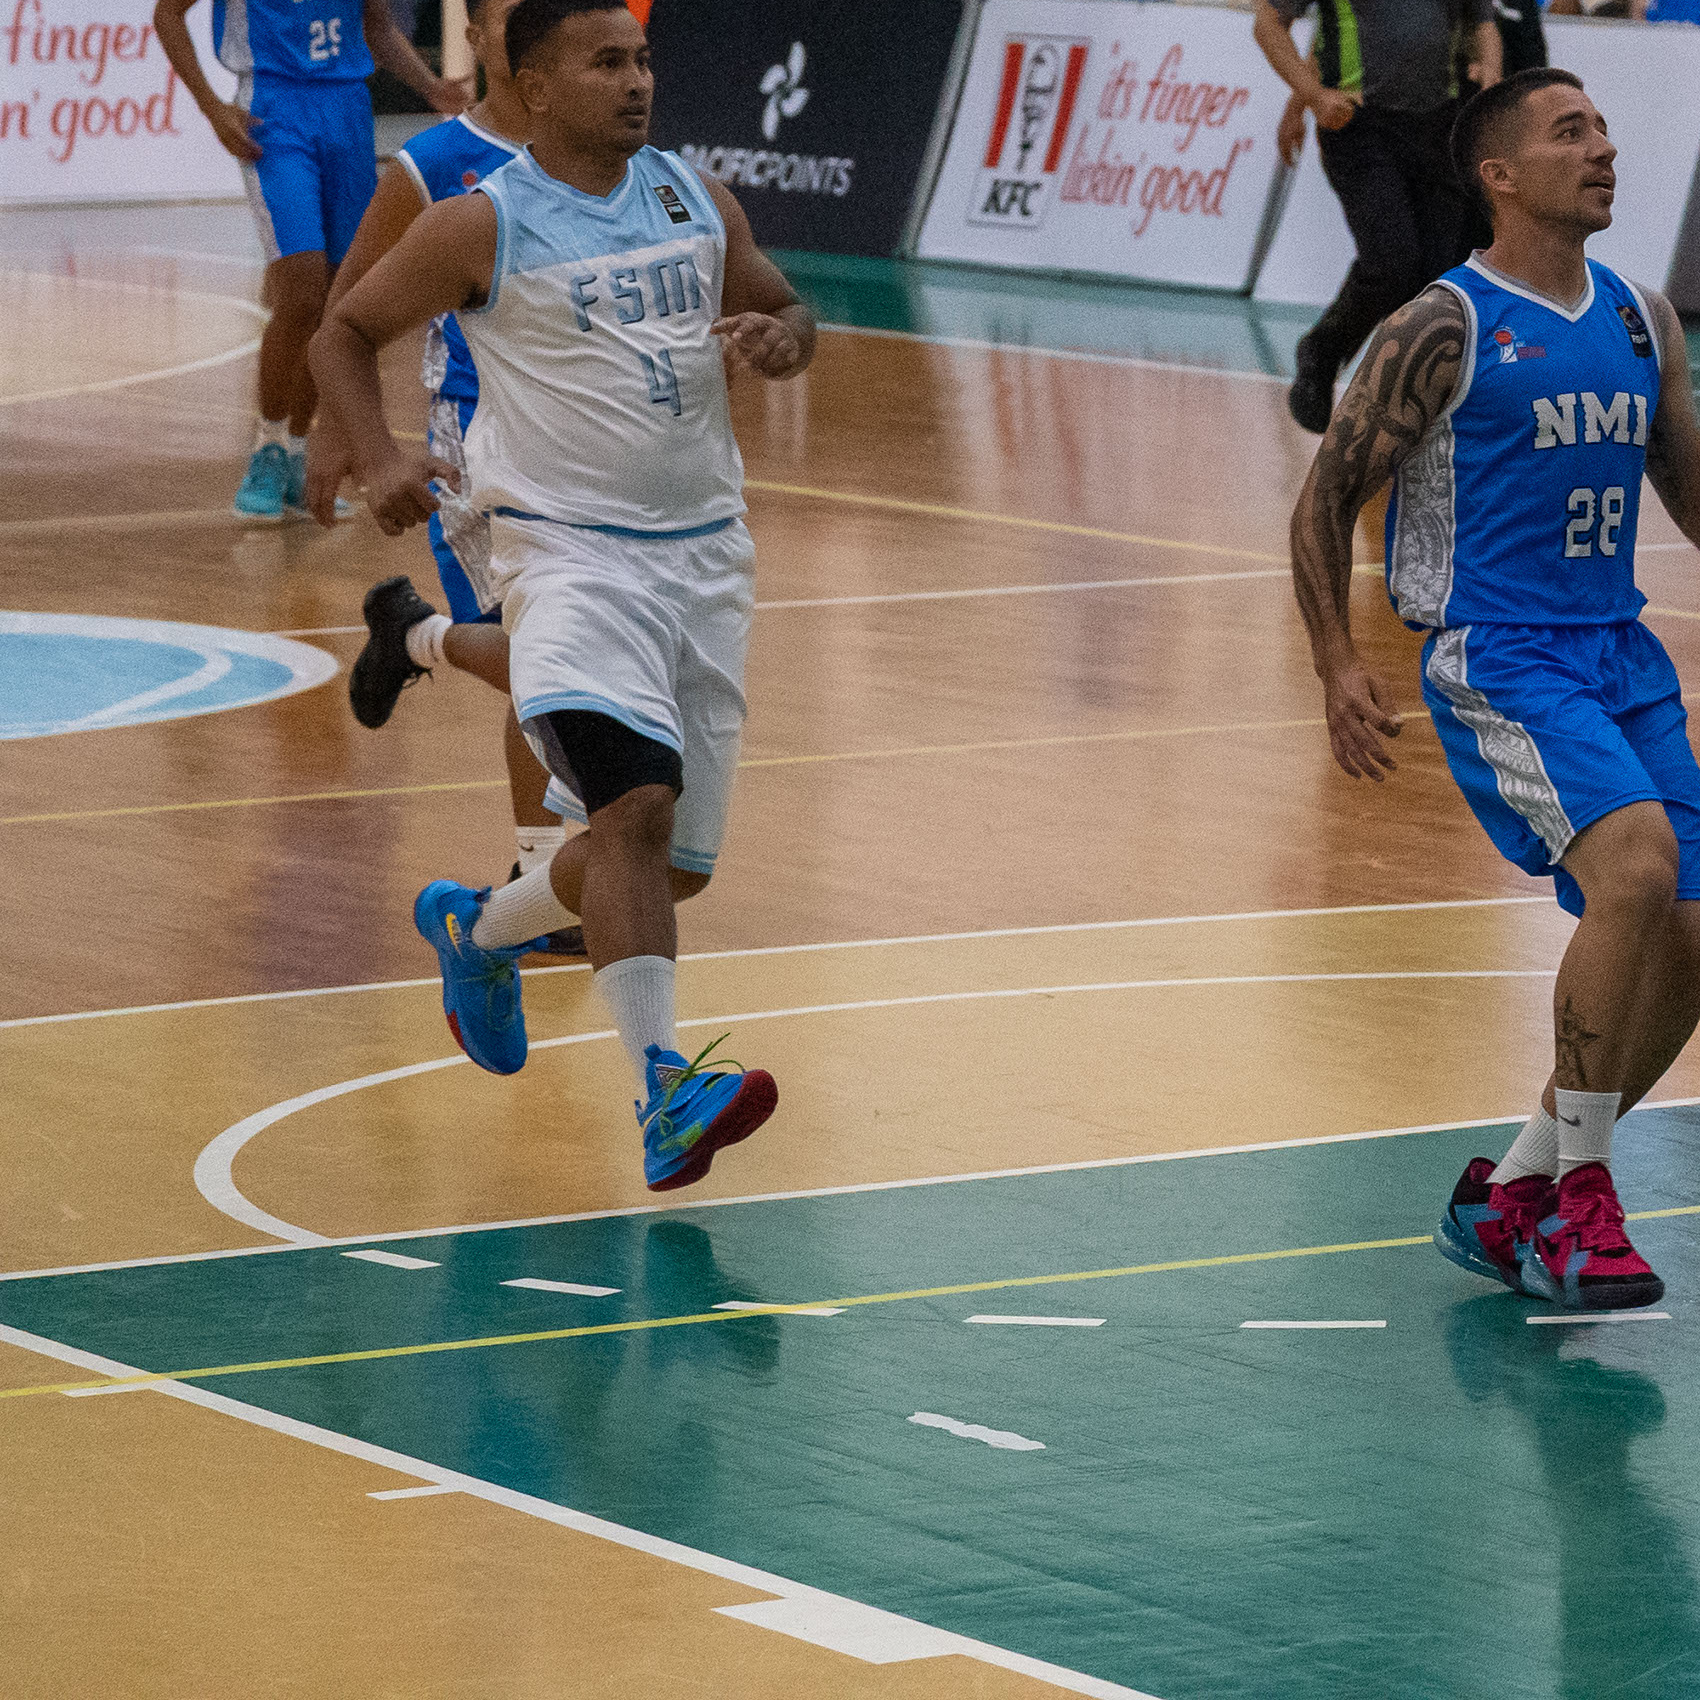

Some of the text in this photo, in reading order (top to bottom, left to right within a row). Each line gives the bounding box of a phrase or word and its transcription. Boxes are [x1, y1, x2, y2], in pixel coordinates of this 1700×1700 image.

[1138, 43, 1251, 154] finger
[569, 254, 701, 333] FSM
[1532, 391, 1649, 450] NMI
[1563, 485, 1626, 559] 28
